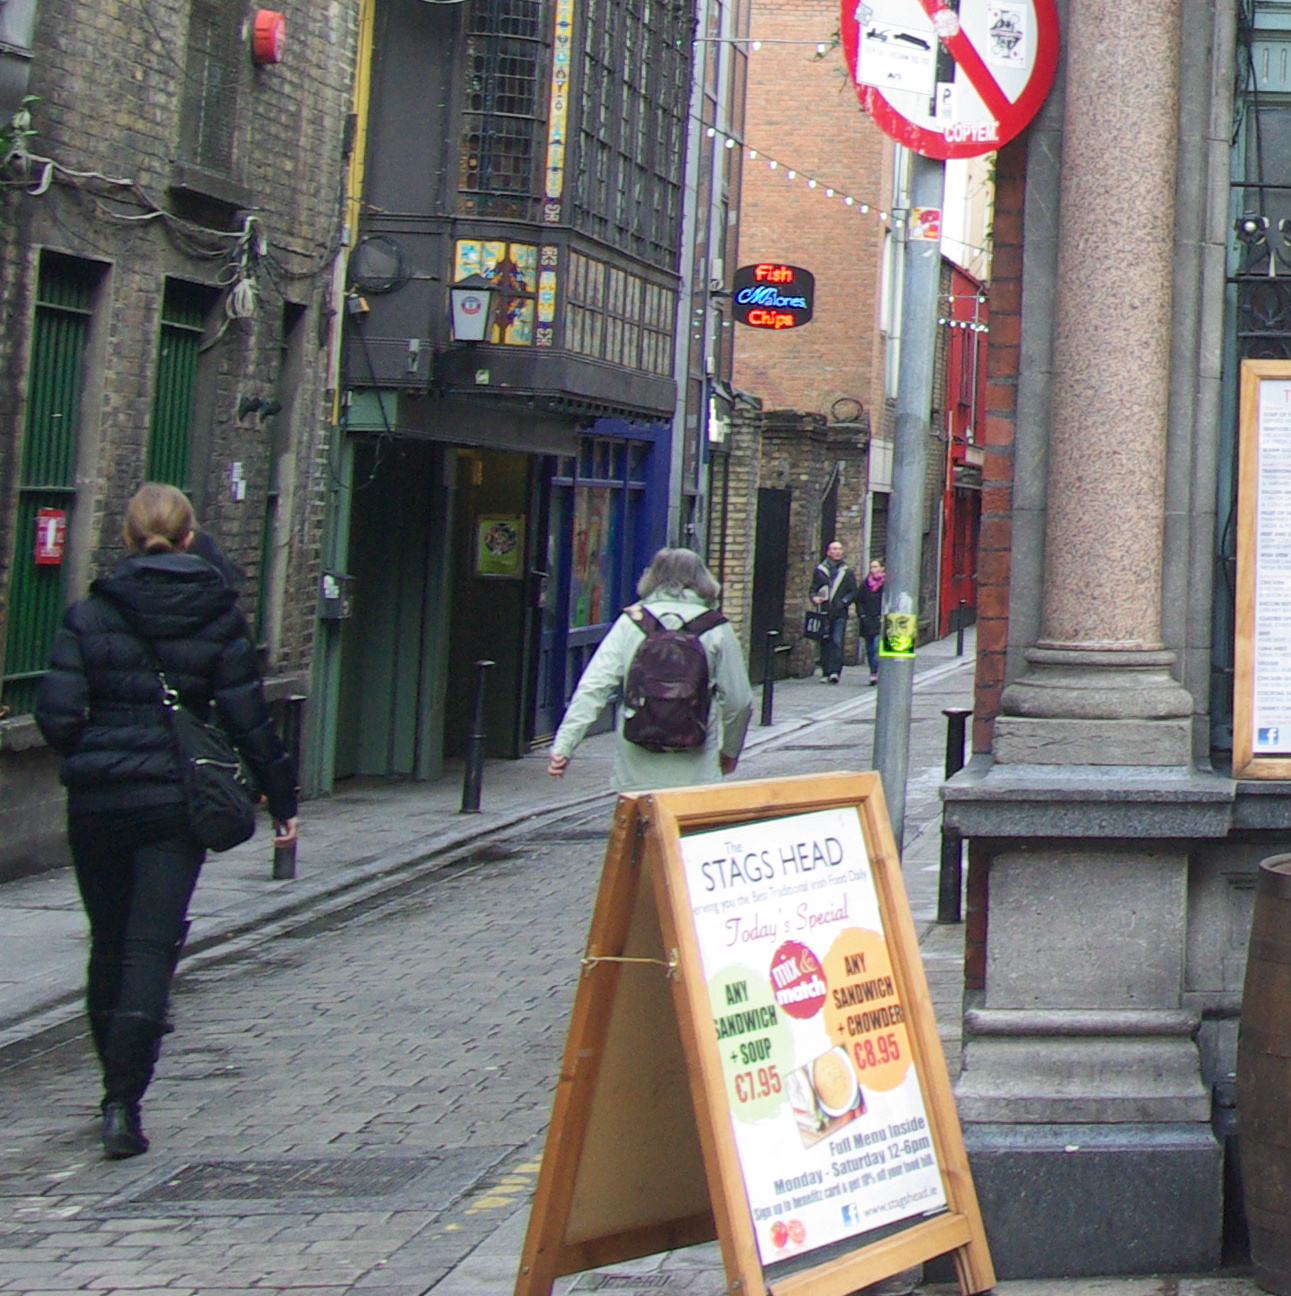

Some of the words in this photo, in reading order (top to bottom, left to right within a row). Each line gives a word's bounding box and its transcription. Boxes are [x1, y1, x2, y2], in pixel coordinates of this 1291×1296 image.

[755, 264, 794, 283] Fish
[748, 309, 795, 330] Chips
[701, 850, 775, 892] STAGS
[779, 837, 844, 876] HEAD
[723, 841, 743, 854] The
[796, 892, 850, 932] Special
[772, 954, 802, 988] mix
[799, 948, 818, 974] &
[844, 952, 868, 978] ANY
[725, 980, 750, 1006] ANY
[775, 974, 827, 1005] match
[832, 975, 896, 1010] SANDWICH
[847, 1004, 906, 1038] CHOWDER
[739, 1037, 773, 1066] SOUP
[853, 1033, 901, 1071] €8.95
[735, 1065, 782, 1104] €7.95
[829, 1137, 852, 1157] Full
[853, 1128, 888, 1150] Menu
[888, 1116, 926, 1139] Inside
[774, 1169, 824, 1196] Monday
[831, 1150, 886, 1178] Saturday
[887, 1136, 931, 1160] 12-6pm
[863, 1186, 938, 1218] www.stagshead.ie
